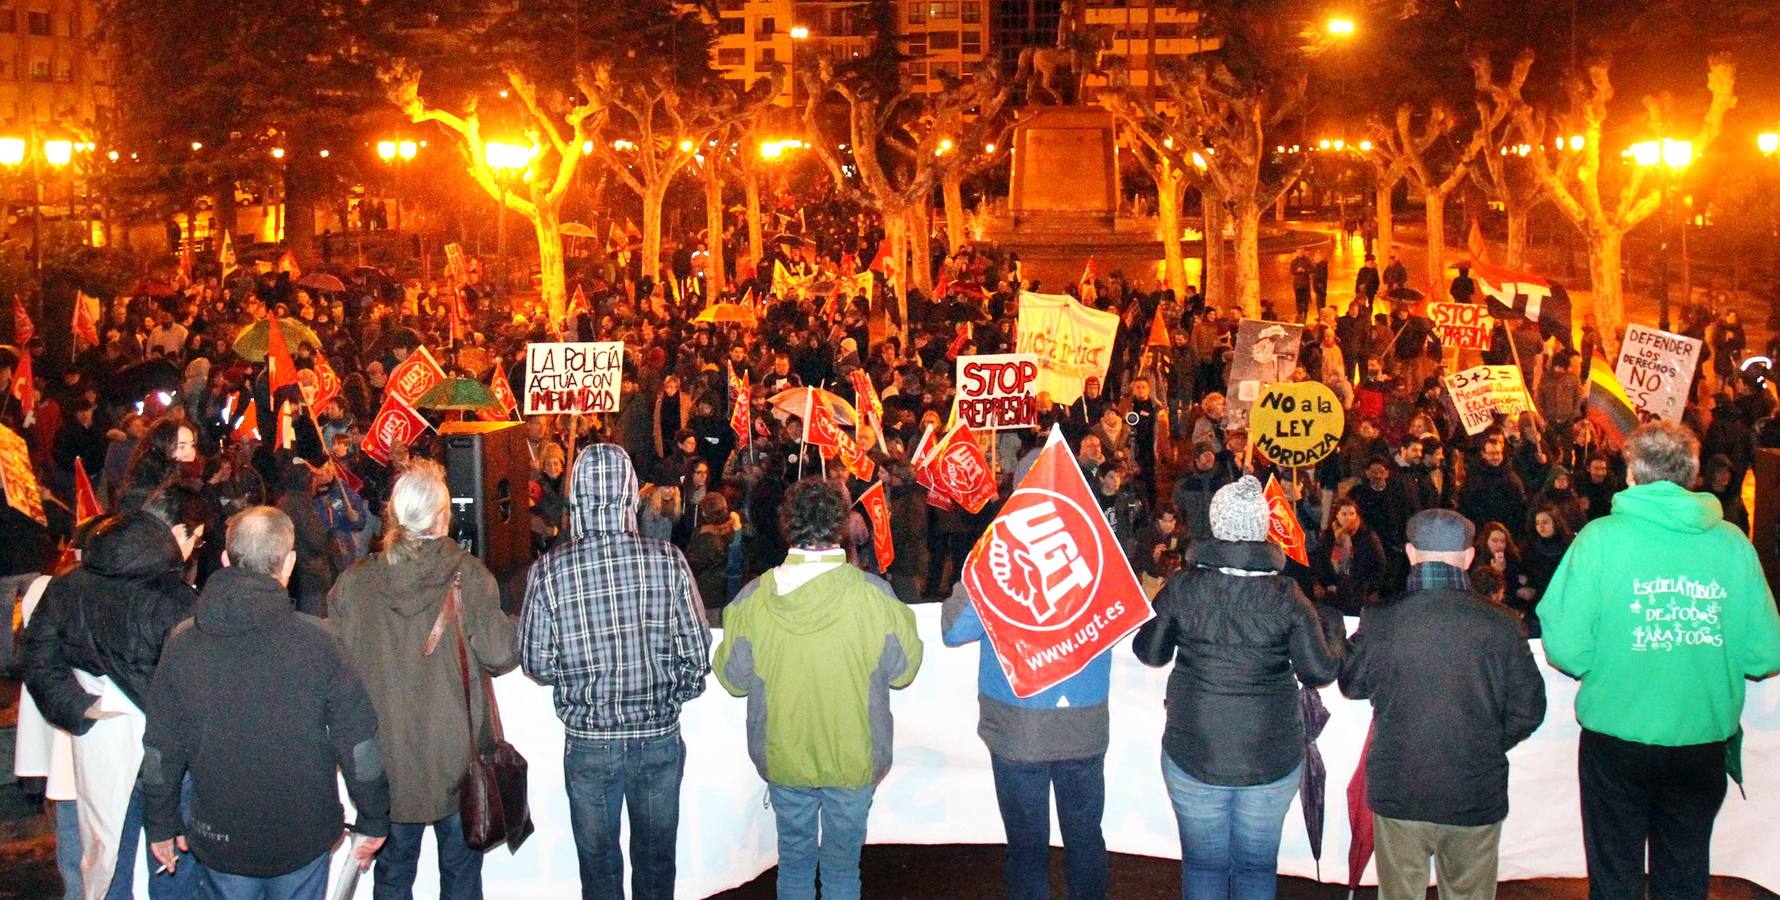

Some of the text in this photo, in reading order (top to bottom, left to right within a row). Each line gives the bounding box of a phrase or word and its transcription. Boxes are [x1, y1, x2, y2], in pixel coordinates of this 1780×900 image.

[1436, 303, 1489, 325] STOP
[1630, 329, 1693, 356] DEFENDER
[1640, 348, 1660, 361] LOS
[531, 348, 555, 374] LA
[1623, 354, 1676, 377] DERECHOS
[528, 369, 577, 393] ACTÚA
[582, 372, 613, 389] CON
[962, 361, 1038, 397] STOP
[1630, 366, 1661, 392] NO
[531, 386, 614, 412] IMPUNIDAD
[959, 390, 1038, 428] REPRESIÓN
[1260, 391, 1333, 413] NO a la
[1276, 420, 1315, 437] LEY
[1257, 433, 1340, 465] MORDAZA
[949, 446, 984, 484] UGT
[1005, 500, 1094, 604] UGT
[1025, 600, 1126, 672] www.ugt.es
